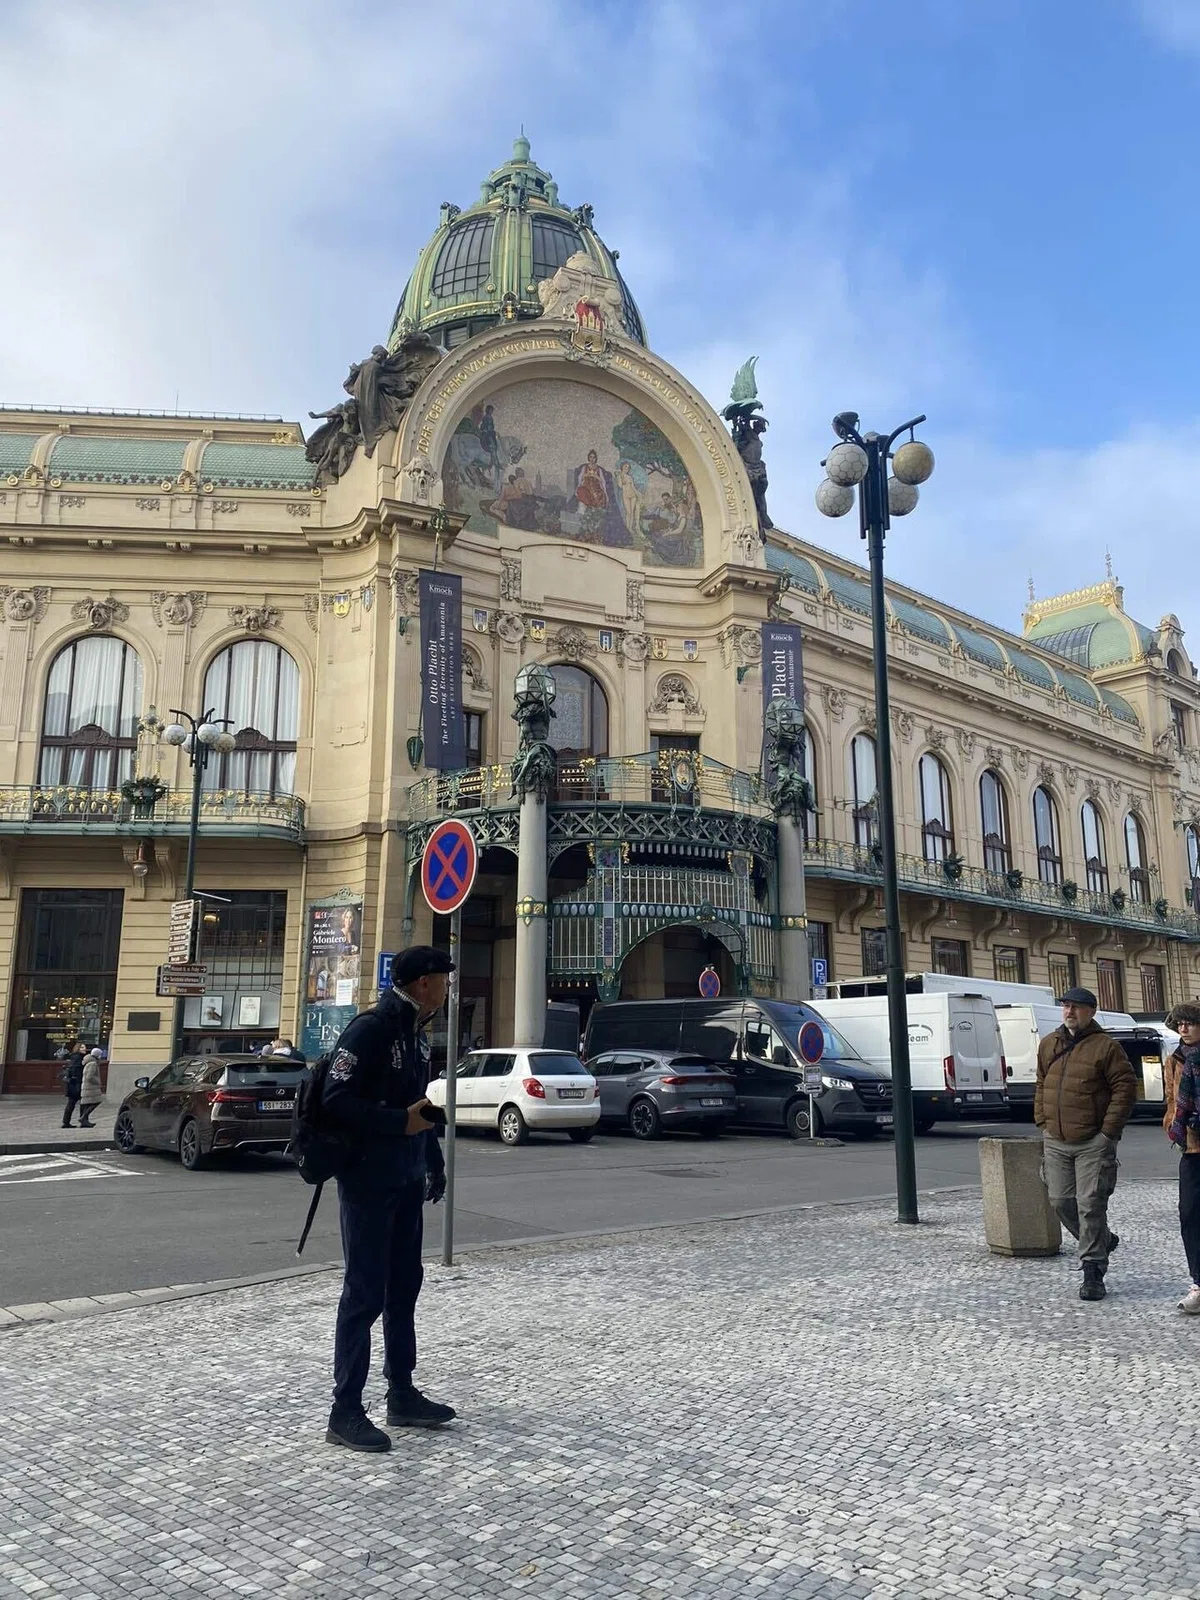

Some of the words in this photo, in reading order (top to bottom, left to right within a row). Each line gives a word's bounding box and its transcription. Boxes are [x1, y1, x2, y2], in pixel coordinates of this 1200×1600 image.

[428, 584, 453, 596] Kmoch
[428, 640, 438, 676] Placht
[439, 644, 446, 653] of
[439, 656, 448, 690] Eternity
[771, 648, 787, 698] Placht
[429, 679, 439, 704] Otto
[440, 692, 448, 727] Fleeting
[312, 935, 347, 944] Montero
